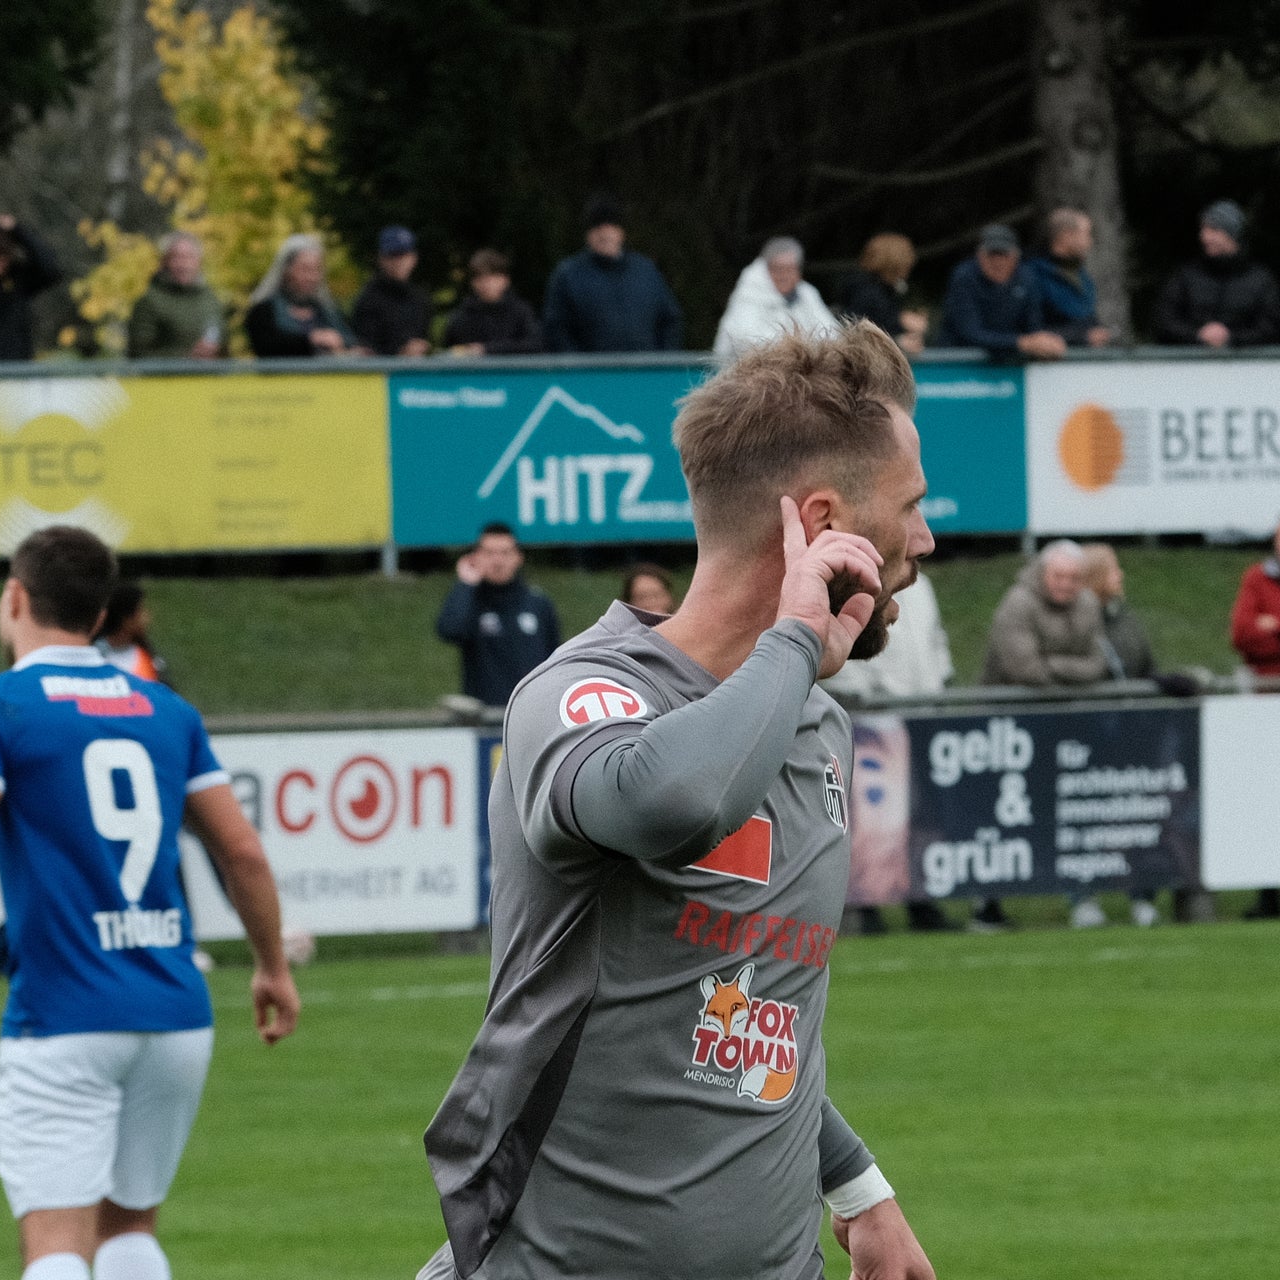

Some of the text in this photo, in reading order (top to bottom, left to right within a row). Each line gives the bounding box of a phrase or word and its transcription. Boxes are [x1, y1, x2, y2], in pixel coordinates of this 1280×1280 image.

[517, 454, 653, 525] HITZ
[929, 717, 1034, 787] gelb
[83, 739, 163, 902] 9
[995, 772, 1034, 827] &
[923, 827, 1034, 898] grün
[694, 1028, 797, 1072] TOWN
[745, 999, 797, 1042] FOX
[683, 1069, 736, 1090] MENDRISIO
